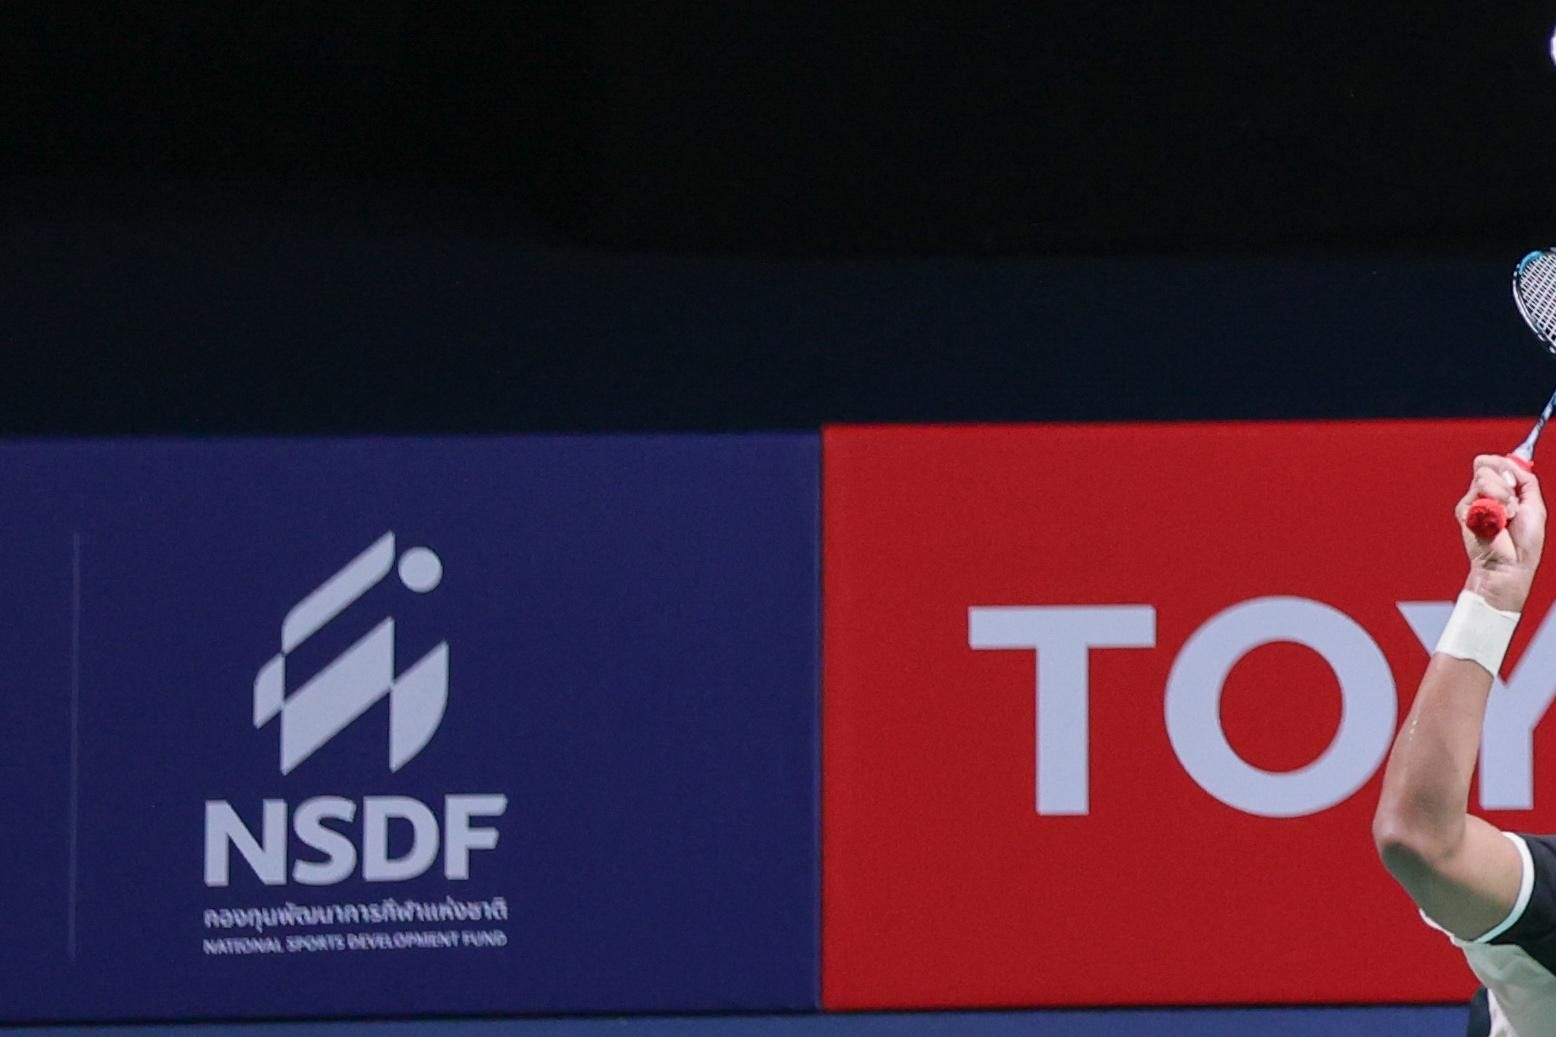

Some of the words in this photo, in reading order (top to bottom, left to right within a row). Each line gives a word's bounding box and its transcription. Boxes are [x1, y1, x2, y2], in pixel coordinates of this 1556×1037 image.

[204, 793, 508, 887] NSDF
[203, 937, 285, 955] NATIONAL
[286, 934, 346, 952] SPORTS
[346, 931, 460, 951] DEVELOPMENT
[462, 929, 508, 948] FUND
